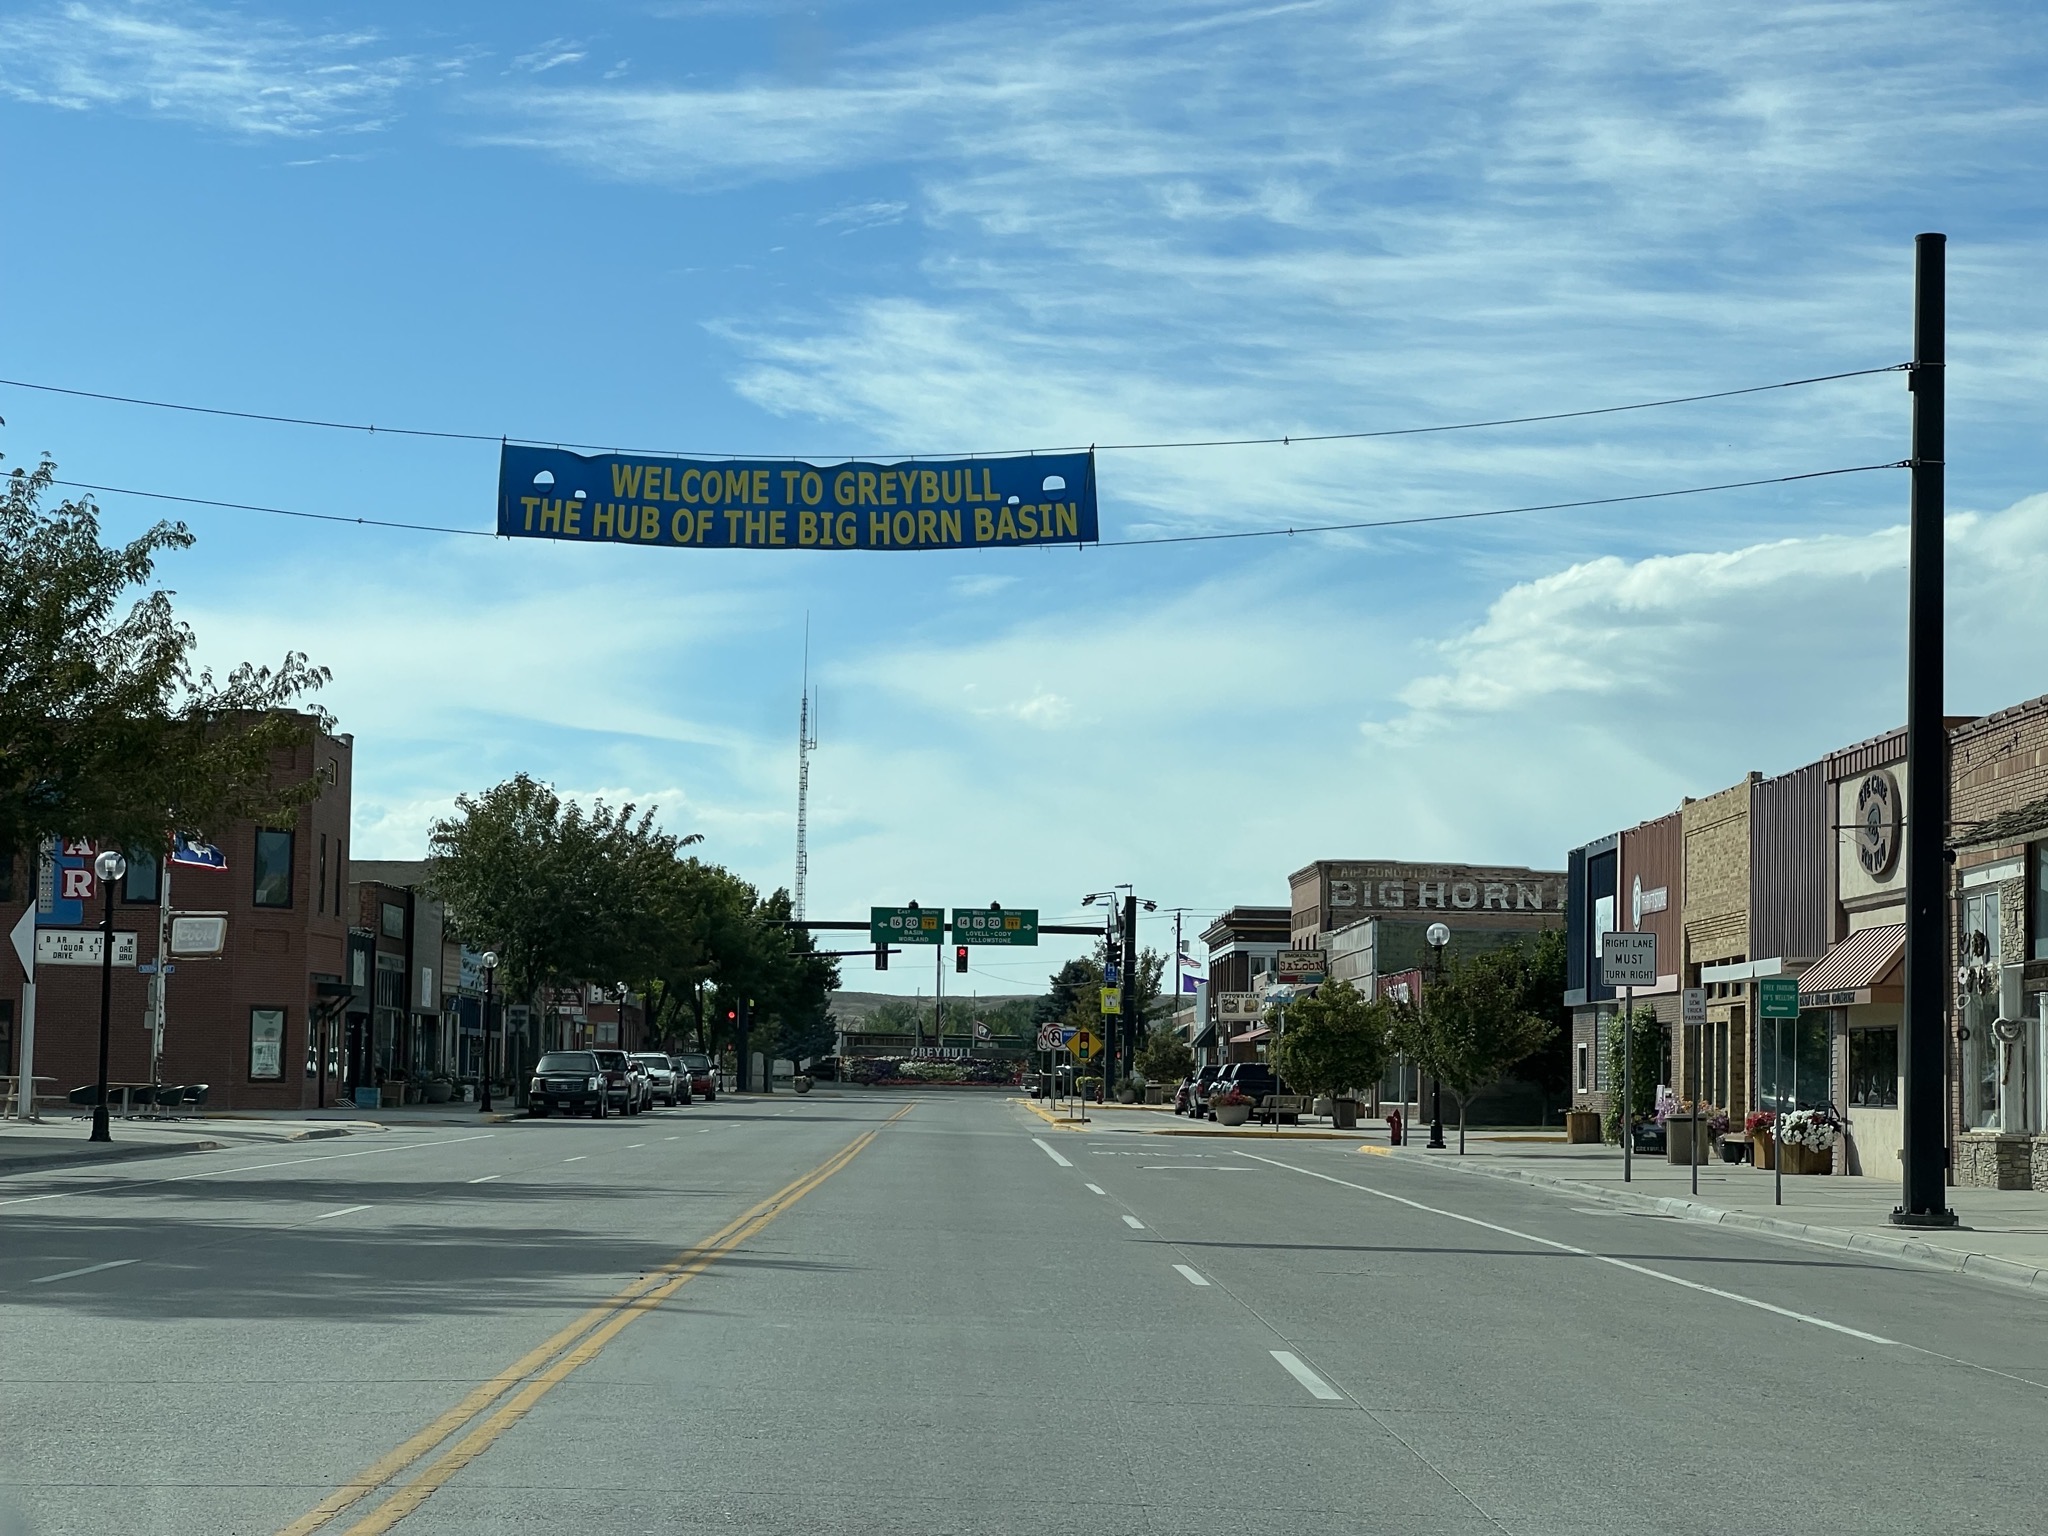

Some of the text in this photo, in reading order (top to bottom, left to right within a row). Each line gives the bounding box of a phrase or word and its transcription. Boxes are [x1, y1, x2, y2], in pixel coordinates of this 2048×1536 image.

[611, 463, 1001, 506] WELCOME TO GREYBULL
[520, 496, 1078, 546] THE HUB OF THE BIG HORN BASIN
[1329, 880, 1405, 908] BIG
[1416, 881, 1544, 910] HORN
[892, 918, 901, 927] 16
[906, 918, 917, 927] 20
[989, 919, 1000, 927] 20
[1605, 939, 1653, 948] RIGHT LANE
[53, 952, 74, 960] DRIVE
[1615, 954, 1644, 964] MUST
[1280, 960, 1324, 971] SALOON
[1605, 970, 1654, 979] TURN RIGHT
[910, 1047, 973, 1058] GREYBULL
